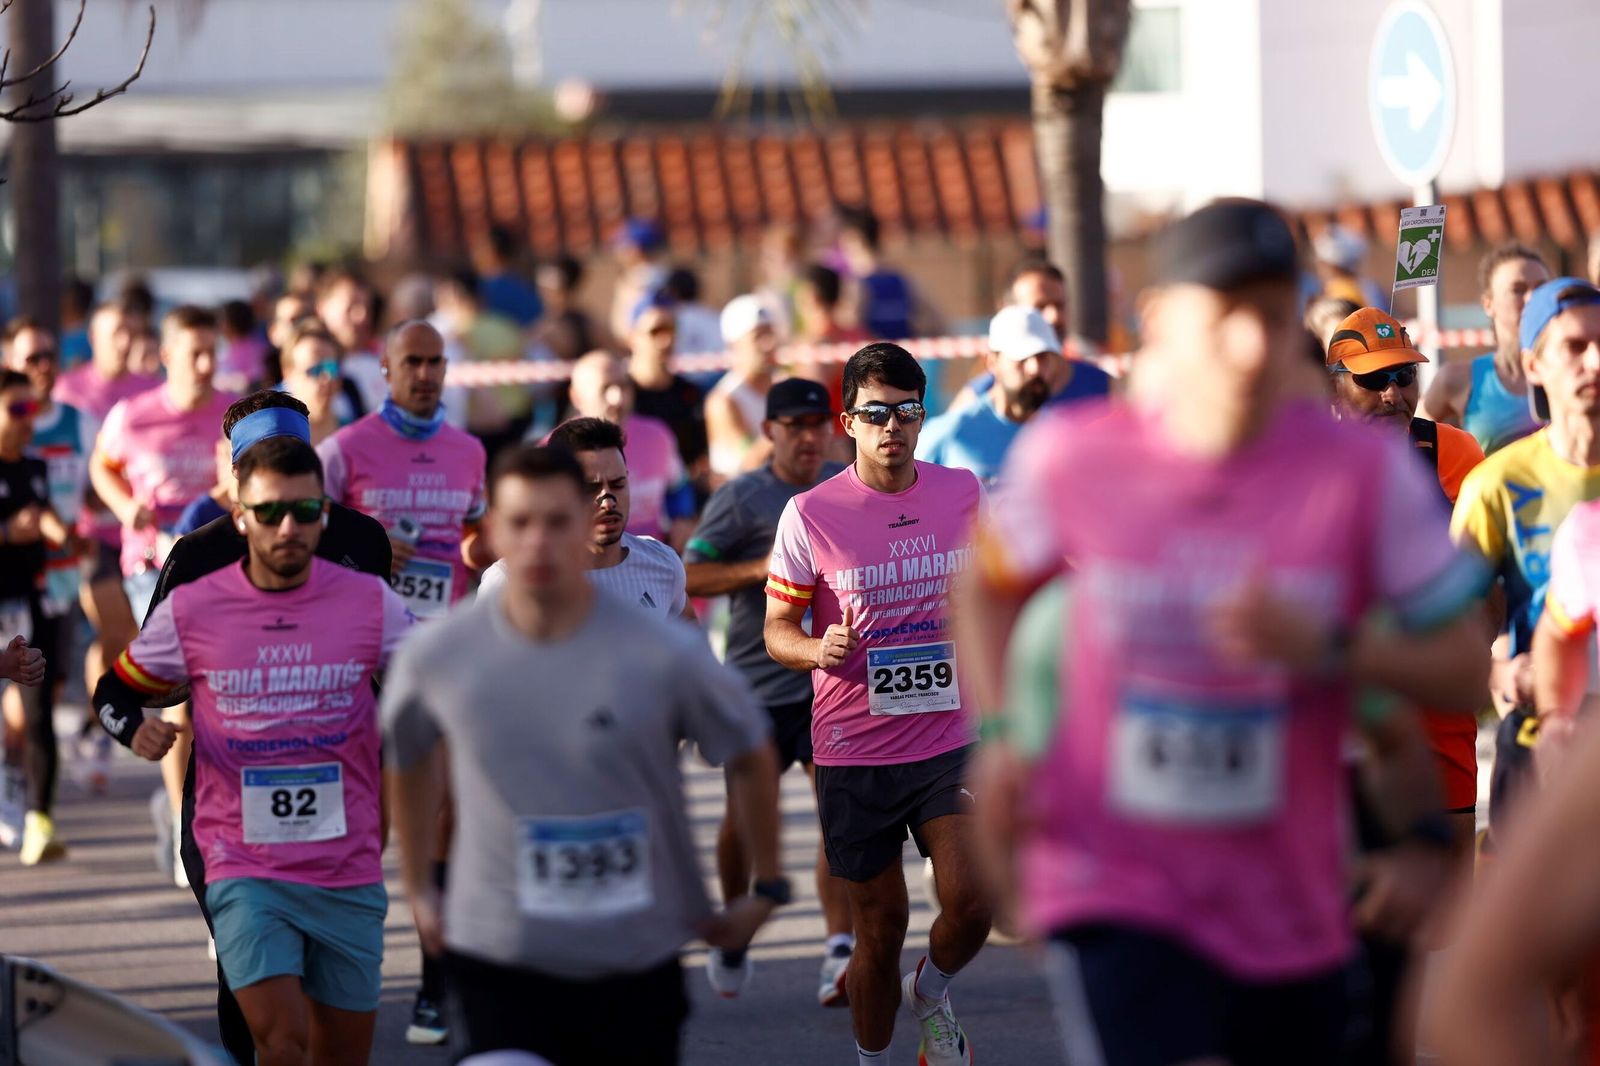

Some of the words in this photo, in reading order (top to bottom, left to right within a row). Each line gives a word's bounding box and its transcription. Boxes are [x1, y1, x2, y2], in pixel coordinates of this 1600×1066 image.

[1421, 268, 1436, 277] DEA
[362, 488, 413, 508] MEDIA
[415, 489, 471, 510] MARAT
[888, 534, 937, 559] XXXVI
[836, 561, 898, 592] MEDIA
[902, 543, 978, 583] MARATÓ
[391, 574, 445, 601] 2521
[848, 578, 948, 608] INTERNACIONAL
[257, 643, 313, 664] XXXVI
[873, 661, 953, 694] 2359
[271, 787, 317, 818] 82
